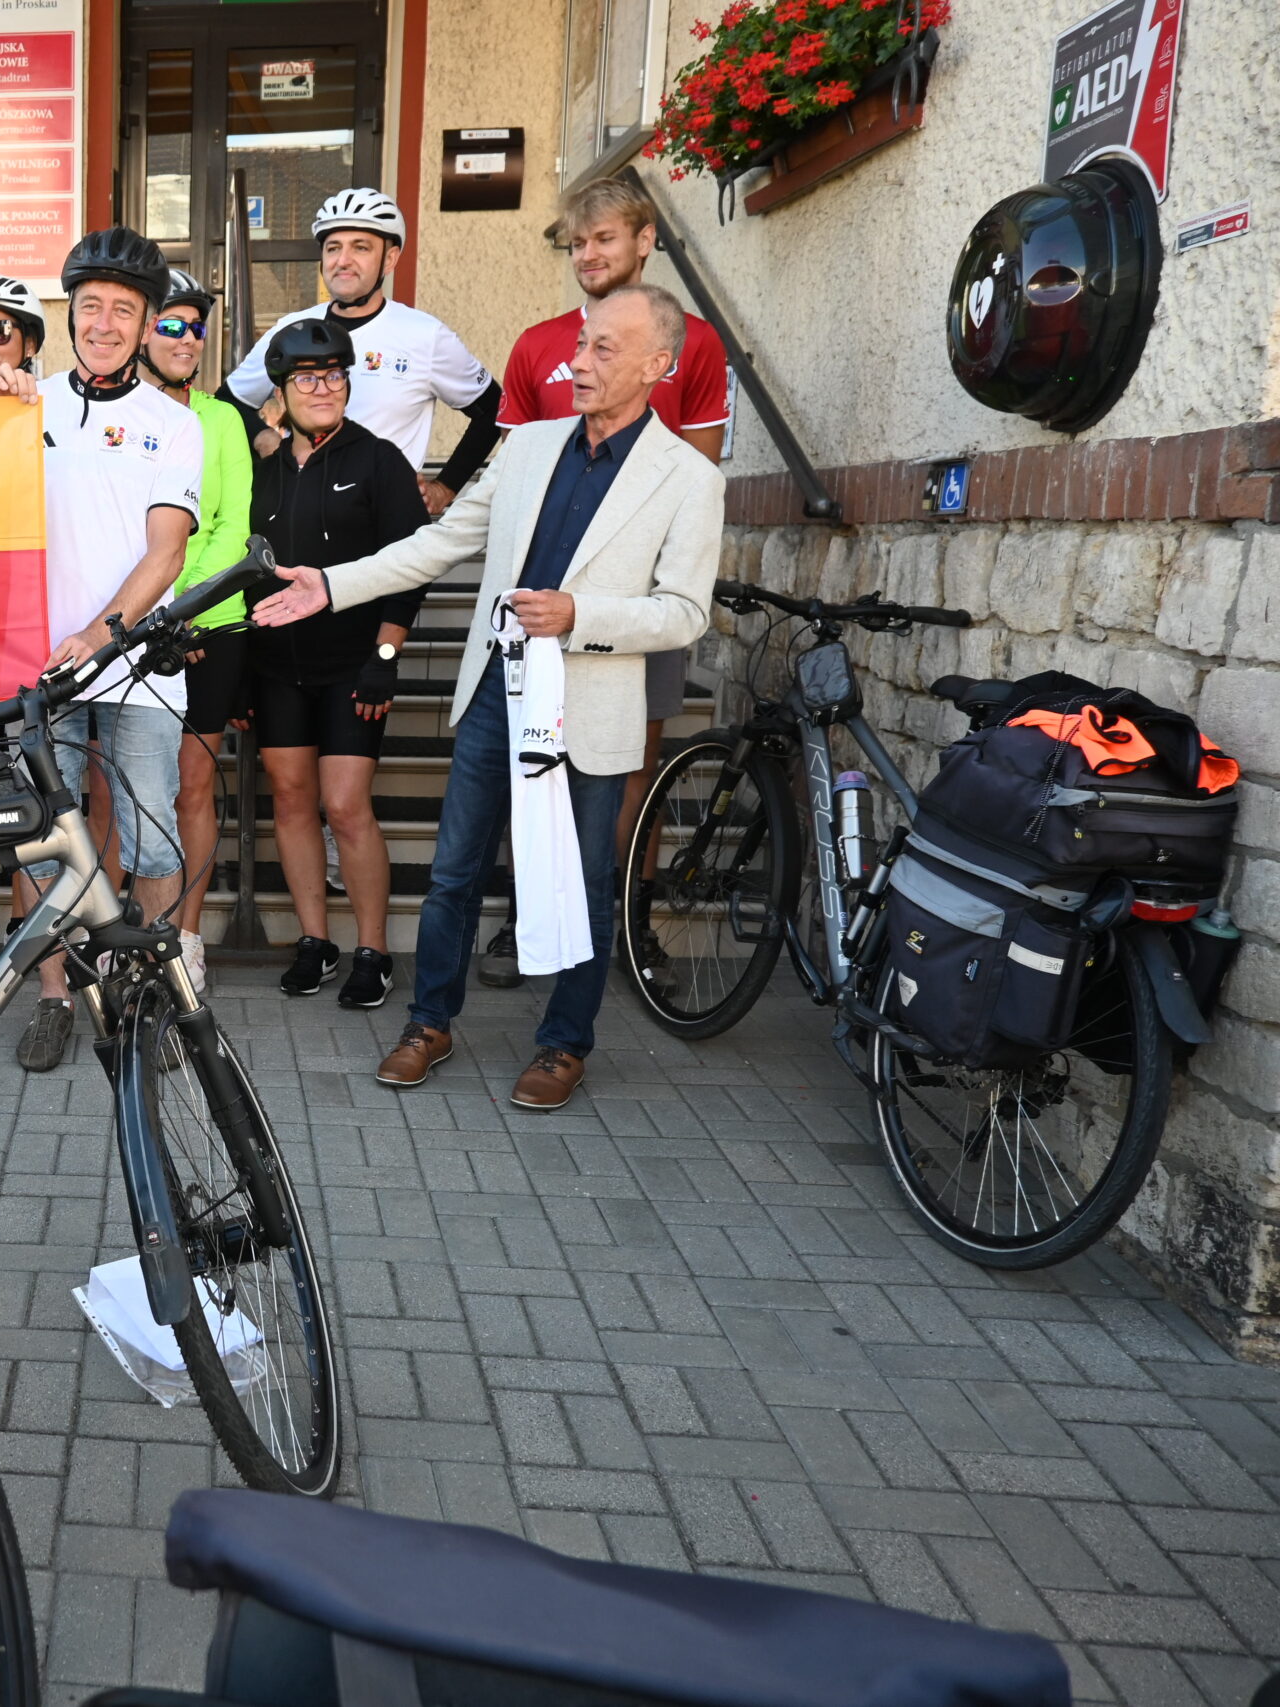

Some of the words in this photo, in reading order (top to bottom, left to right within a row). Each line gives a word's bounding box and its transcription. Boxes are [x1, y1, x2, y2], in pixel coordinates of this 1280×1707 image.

[2, 0, 12, 10] in
[15, 0, 58, 9] Proskau
[1054, 27, 1133, 84] DEFIBRYLATOR
[263, 61, 310, 75] UWAGA
[1072, 54, 1129, 123] AED
[1, 174, 41, 184] Proskau
[12, 210, 60, 221] POMOCY
[8, 255, 46, 265] Proskau
[807, 742, 843, 923] KROSS
